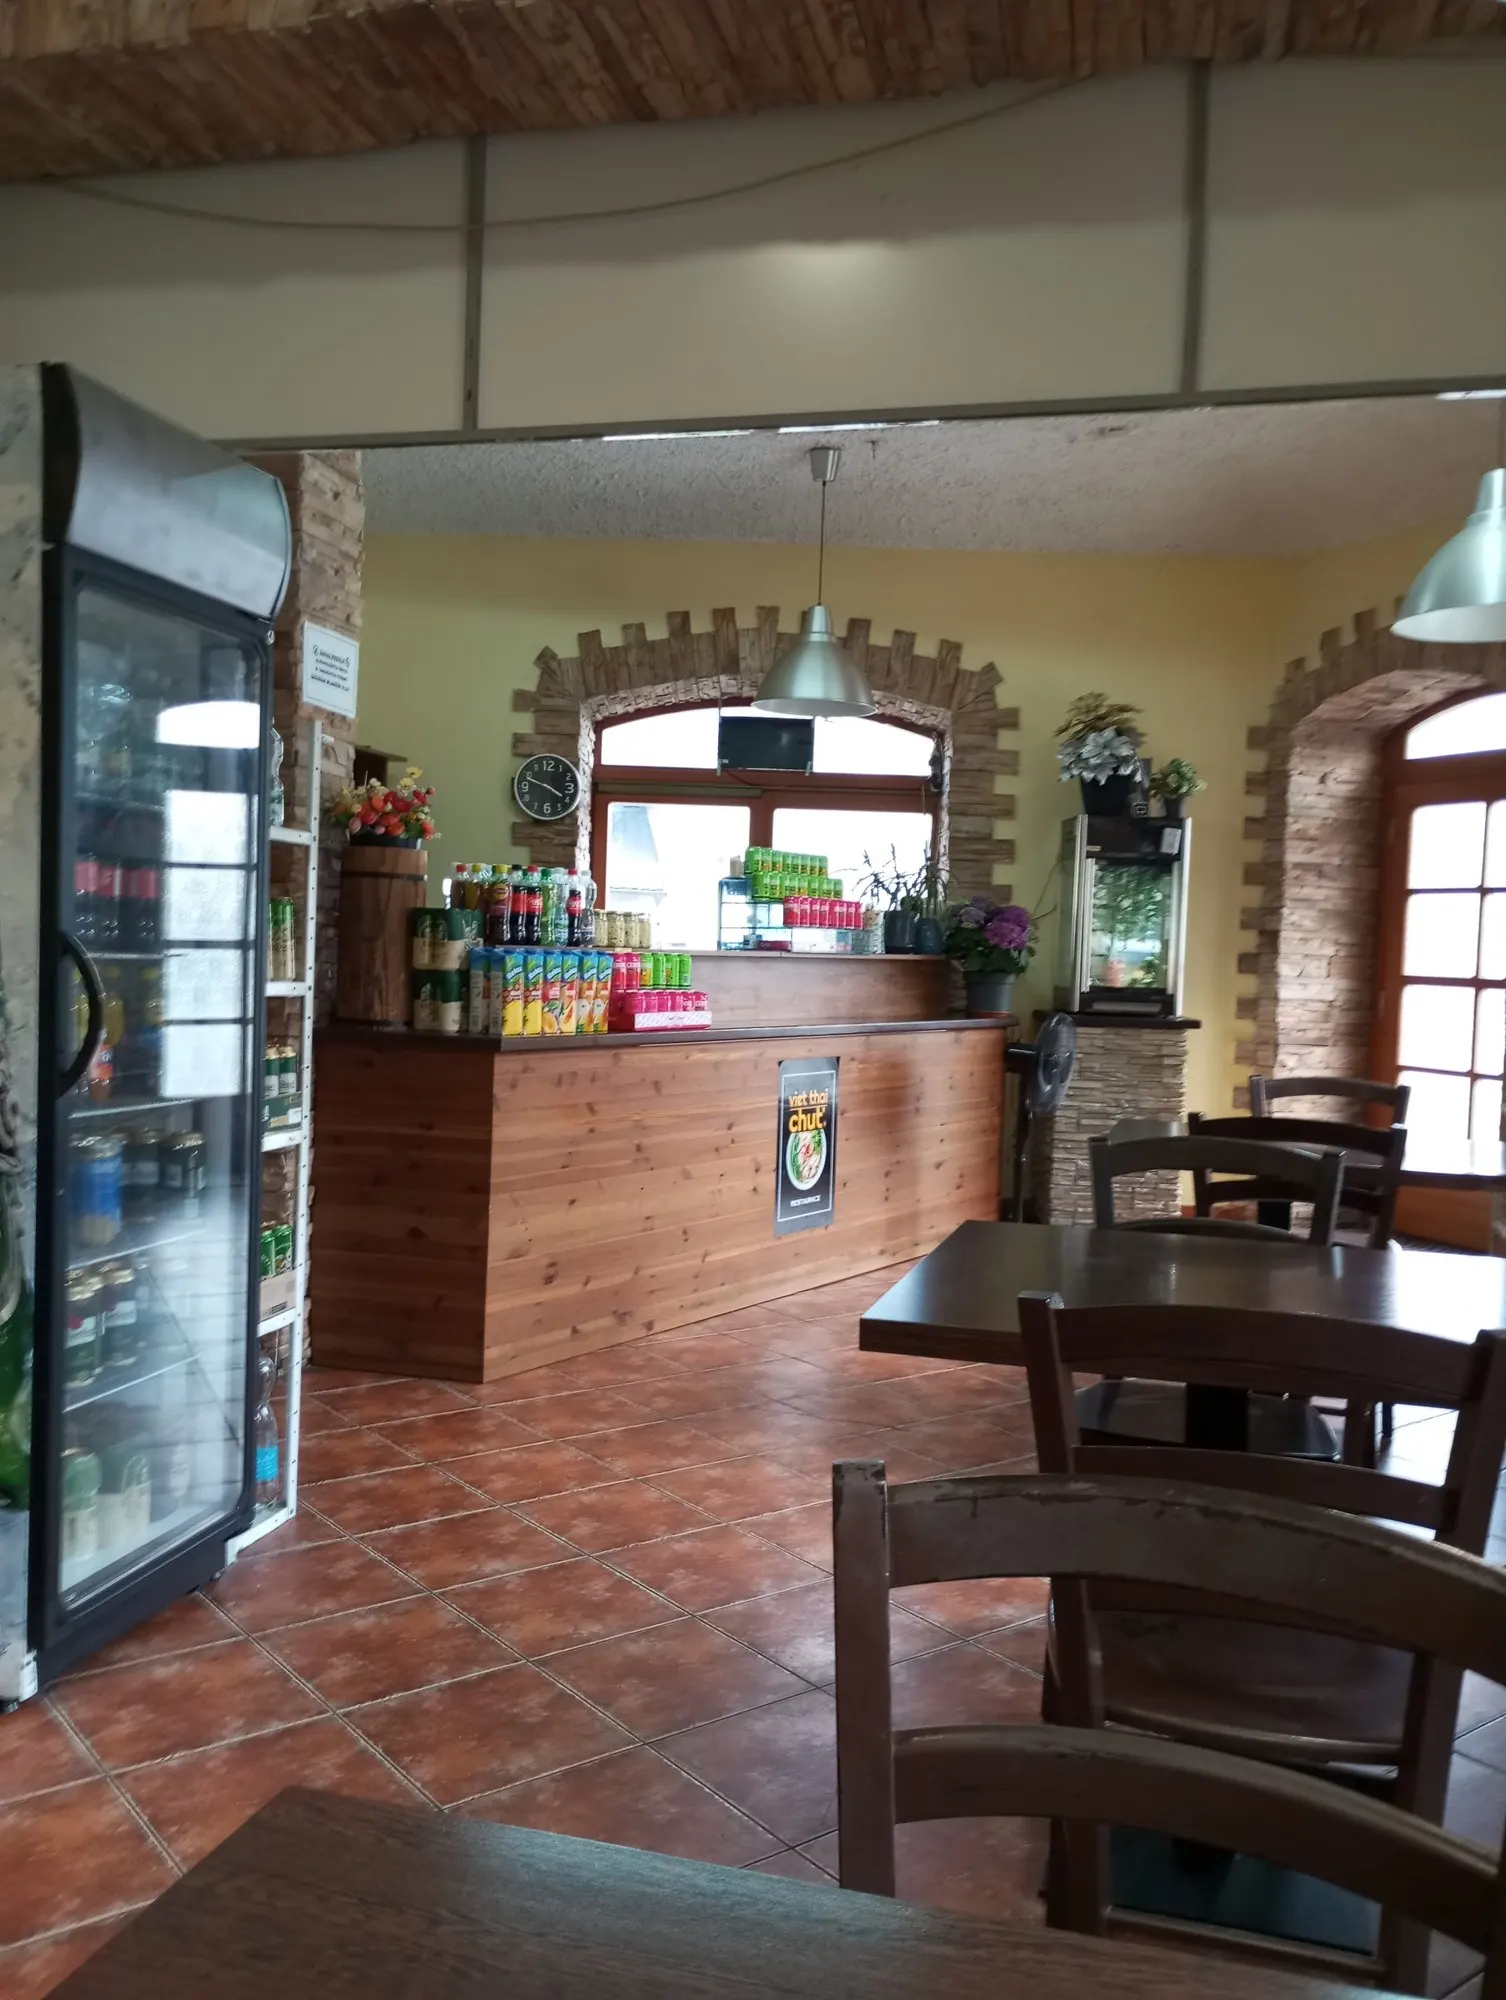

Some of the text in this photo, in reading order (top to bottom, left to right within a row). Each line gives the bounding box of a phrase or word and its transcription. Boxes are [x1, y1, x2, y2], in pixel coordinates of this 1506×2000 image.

[543, 760, 555, 771] 12
[522, 782, 529, 792] 9
[565, 783, 574, 793] 3
[524, 794, 529, 802] 8
[533, 802, 538, 810] 7
[543, 803, 551, 814] 6
[557, 803, 562, 811] 5
[808, 1087, 829, 1105] thai
